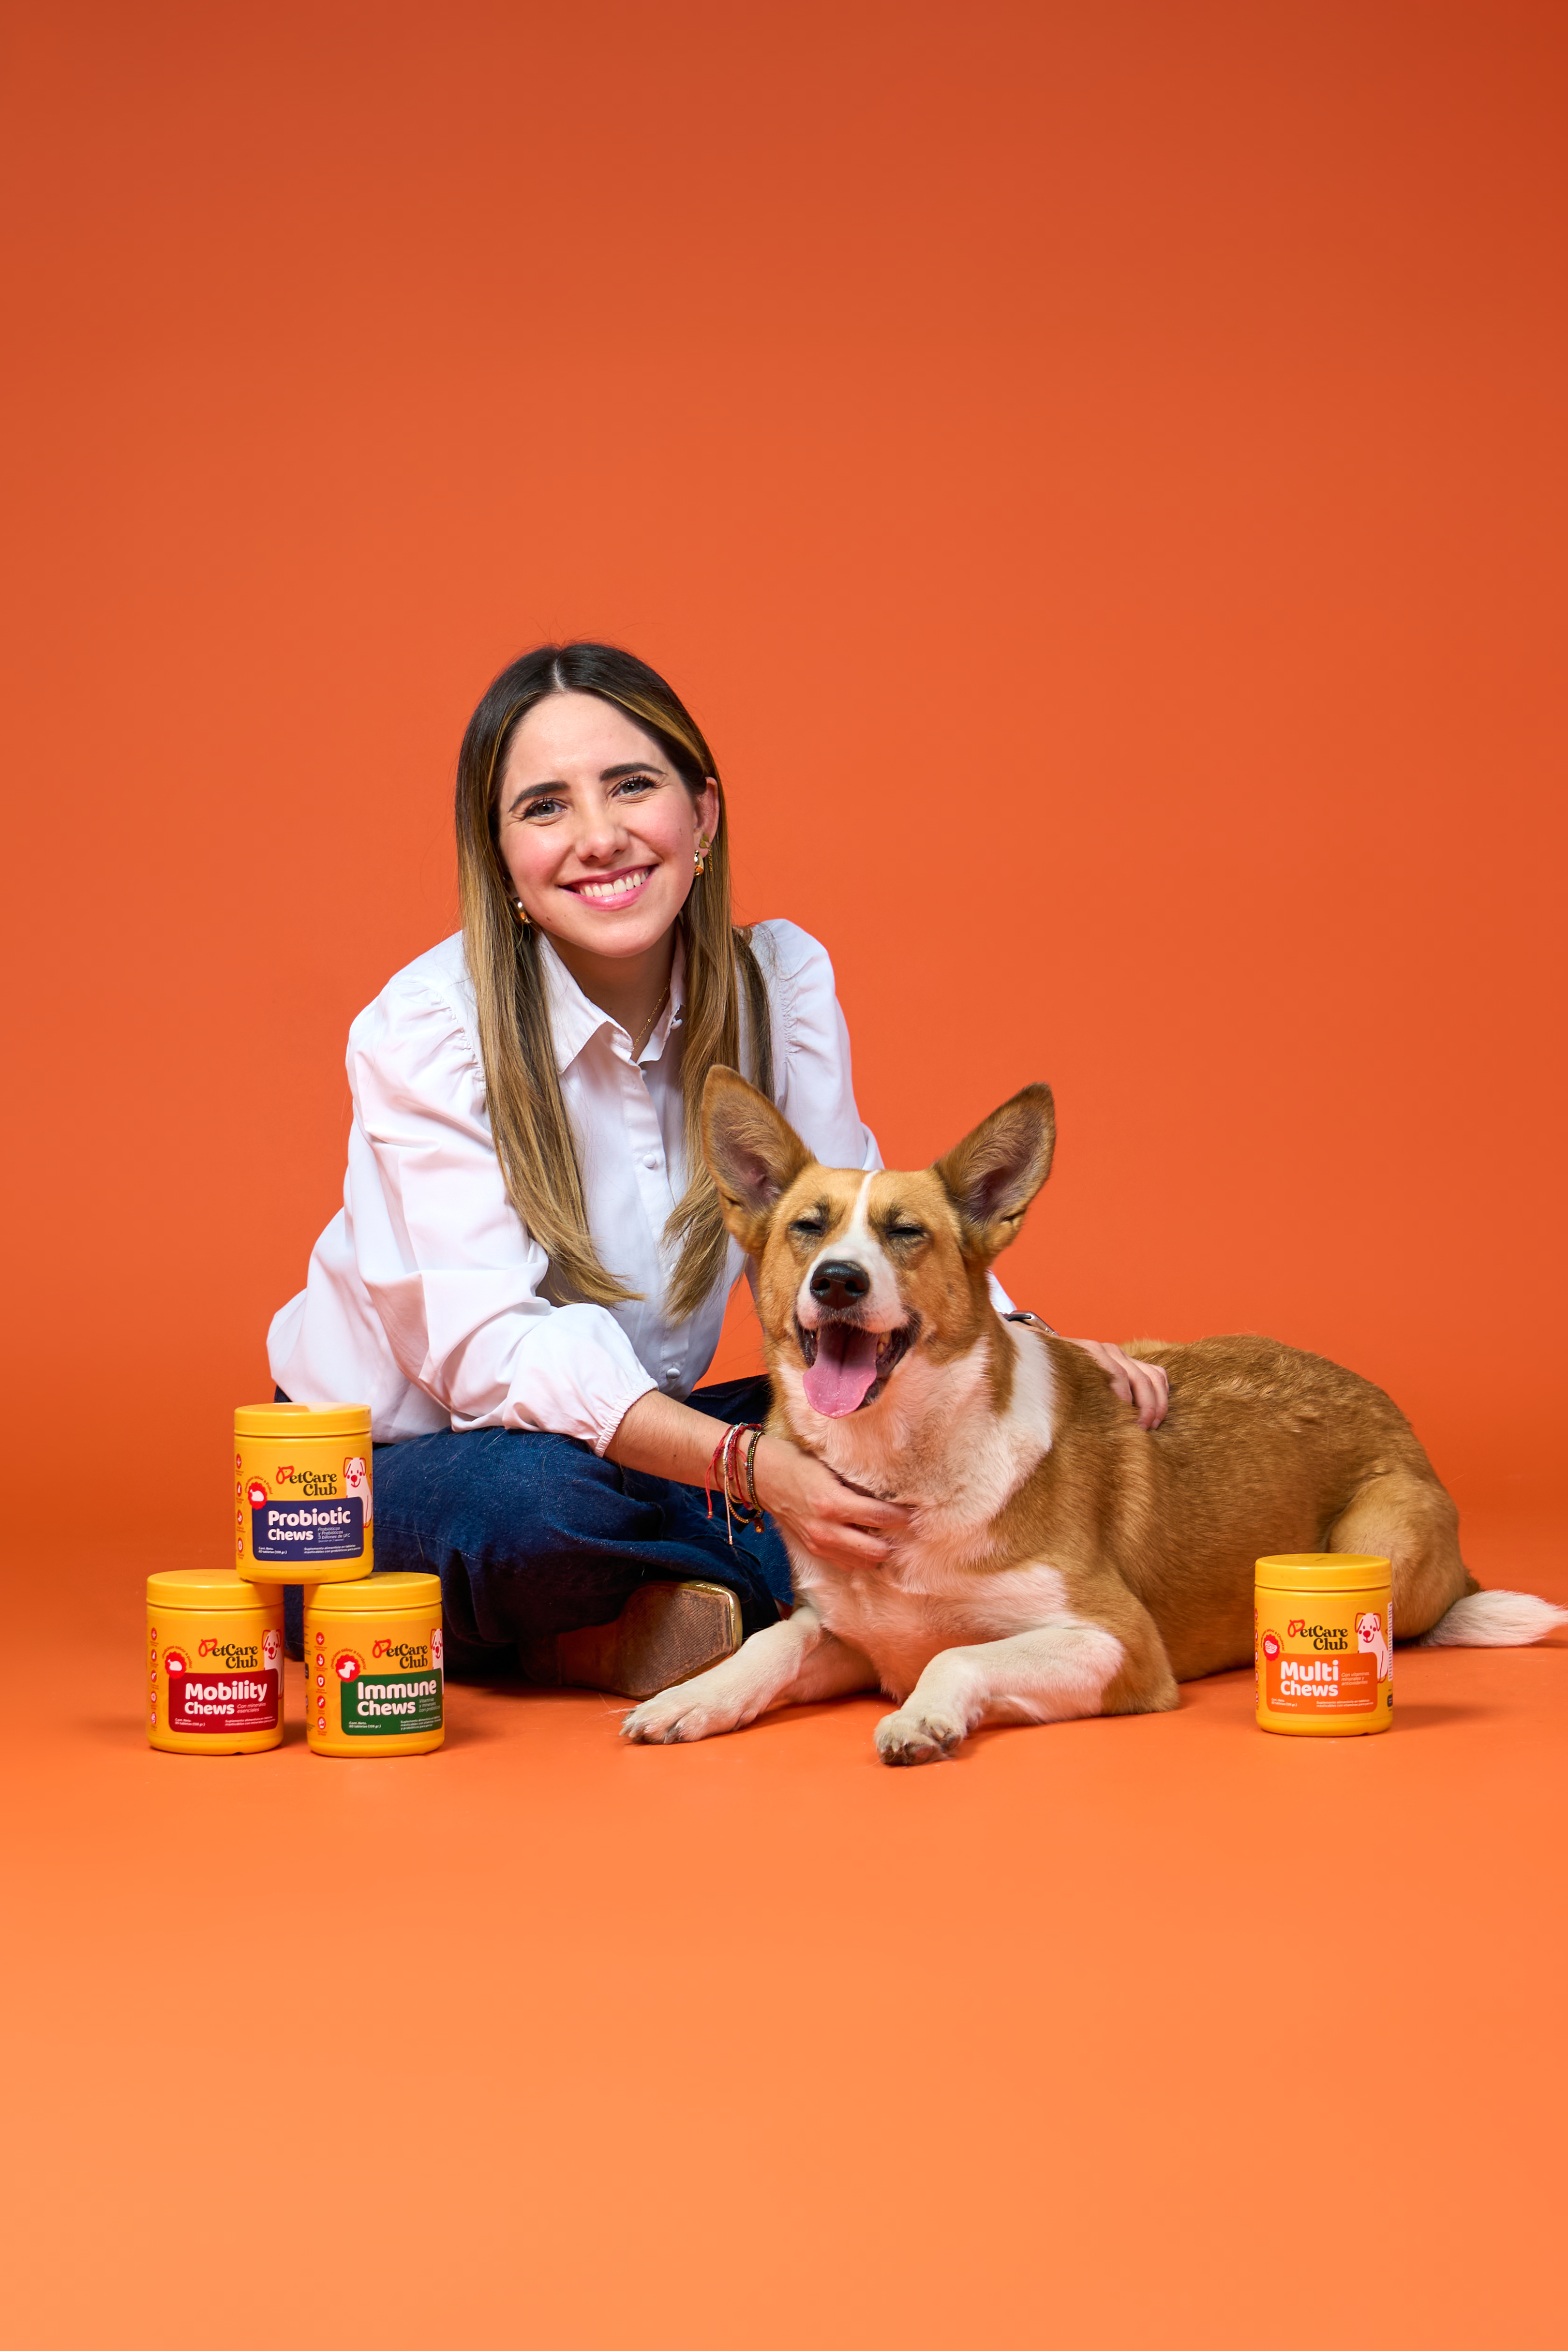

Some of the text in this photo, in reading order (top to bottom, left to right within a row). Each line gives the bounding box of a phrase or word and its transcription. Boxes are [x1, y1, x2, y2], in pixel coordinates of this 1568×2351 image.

[276, 1465, 337, 1484] PetCare
[303, 1483, 337, 1496] Club
[268, 1507, 351, 1526] Probiotic
[268, 1529, 313, 1541] Chews
[1288, 1619, 1348, 1638] PetCare
[199, 1638, 258, 1657] PetCare
[372, 1639, 428, 1658] PetCare
[1313, 1636, 1348, 1650] Club
[226, 1655, 258, 1669] Club
[399, 1655, 428, 1669] Club
[1280, 1659, 1339, 1682] Multi
[185, 1680, 267, 1702] Mobility
[357, 1679, 437, 1700] Immune
[1280, 1680, 1339, 1697] Chews
[185, 1702, 235, 1715] Chews
[357, 1700, 416, 1716] Chews
